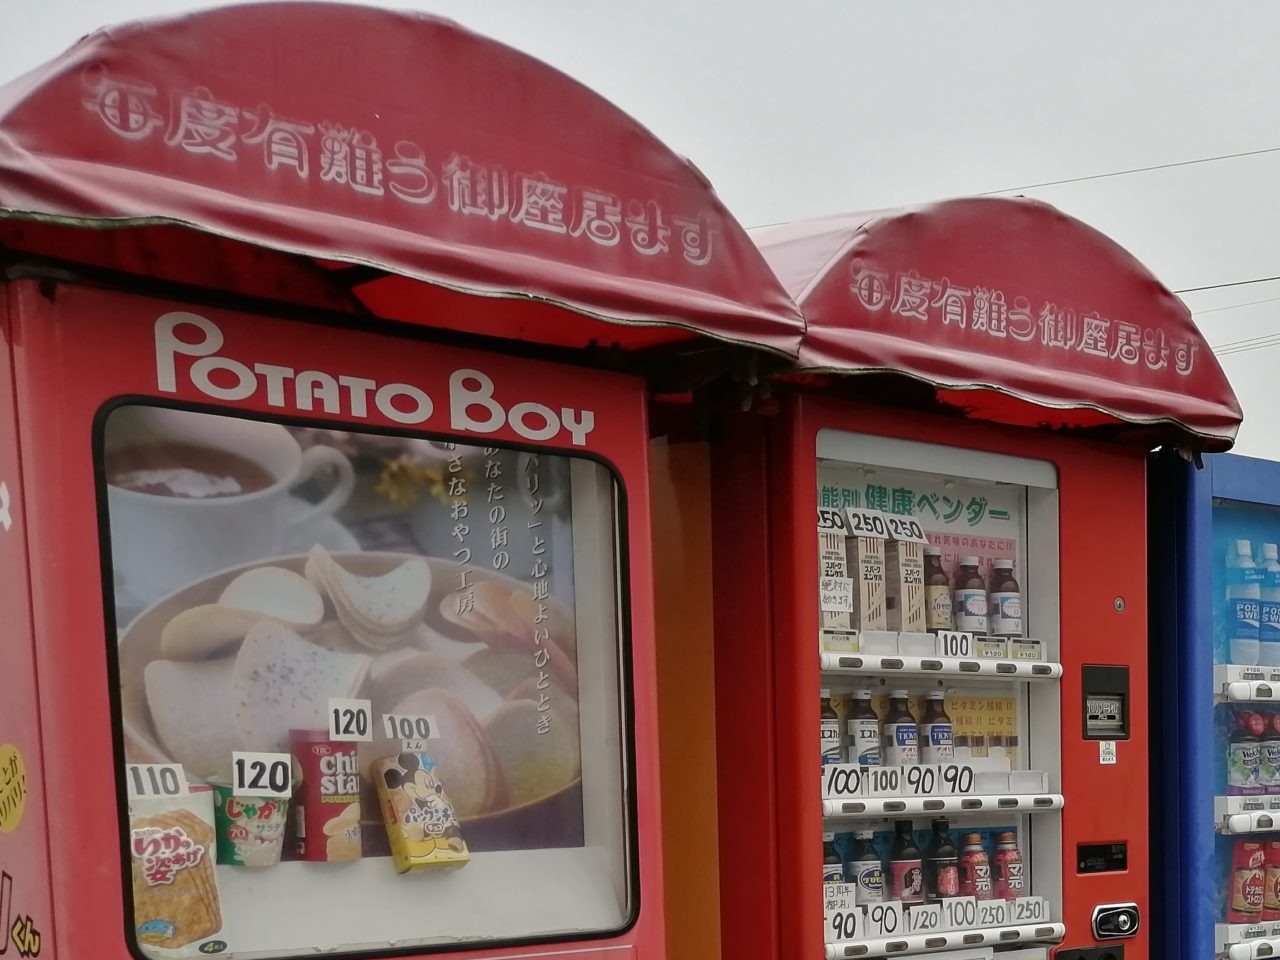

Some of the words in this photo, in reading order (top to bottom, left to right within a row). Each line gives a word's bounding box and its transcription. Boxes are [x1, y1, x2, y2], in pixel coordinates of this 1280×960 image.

[817, 484, 1010, 525] 能別健康ベンダー
[852, 512, 885, 535] 250
[889, 518, 923, 540] 250
[1236, 611, 1260, 620] SWE
[943, 633, 969, 657] 100
[333, 708, 368, 736] 120
[388, 715, 430, 740] 100
[235, 758, 290, 793] 120
[320, 751, 358, 775] chi
[130, 766, 180, 796] 110
[828, 767, 860, 796] 100
[872, 770, 899, 792] 100
[908, 766, 934, 794] 90
[943, 765, 973, 793] 90
[872, 905, 898, 935] 90
[913, 910, 938, 930] 120
[947, 900, 975, 926] 100
[981, 905, 1005, 924] 250
[1016, 900, 1040, 920] 250
[832, 912, 856, 940] 90
